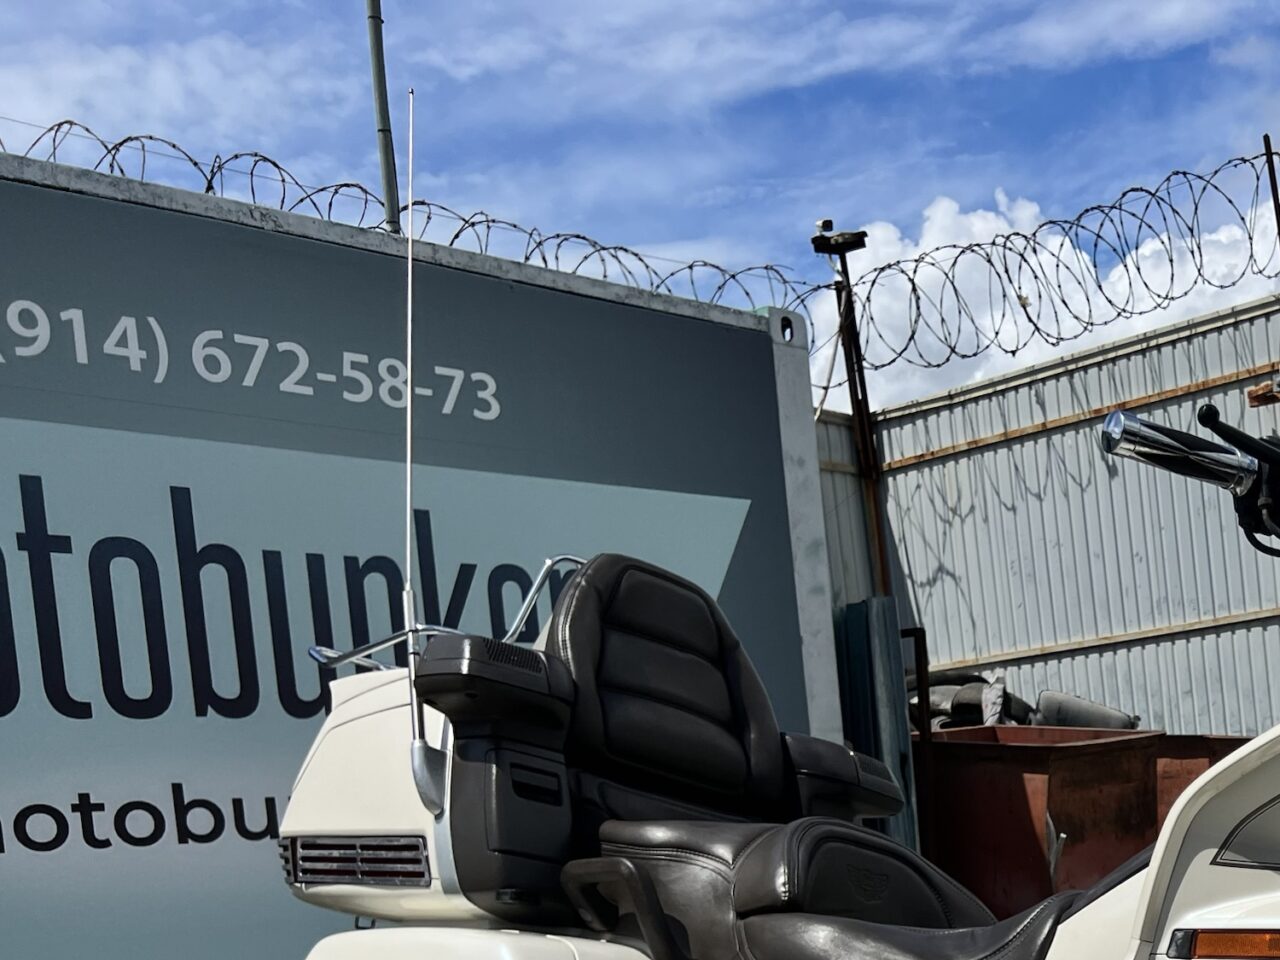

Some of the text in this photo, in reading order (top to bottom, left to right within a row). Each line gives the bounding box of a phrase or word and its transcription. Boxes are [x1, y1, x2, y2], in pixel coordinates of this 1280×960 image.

[0, 300, 500, 421] 914) 672-58-73
[0, 783, 291, 854] otobu
